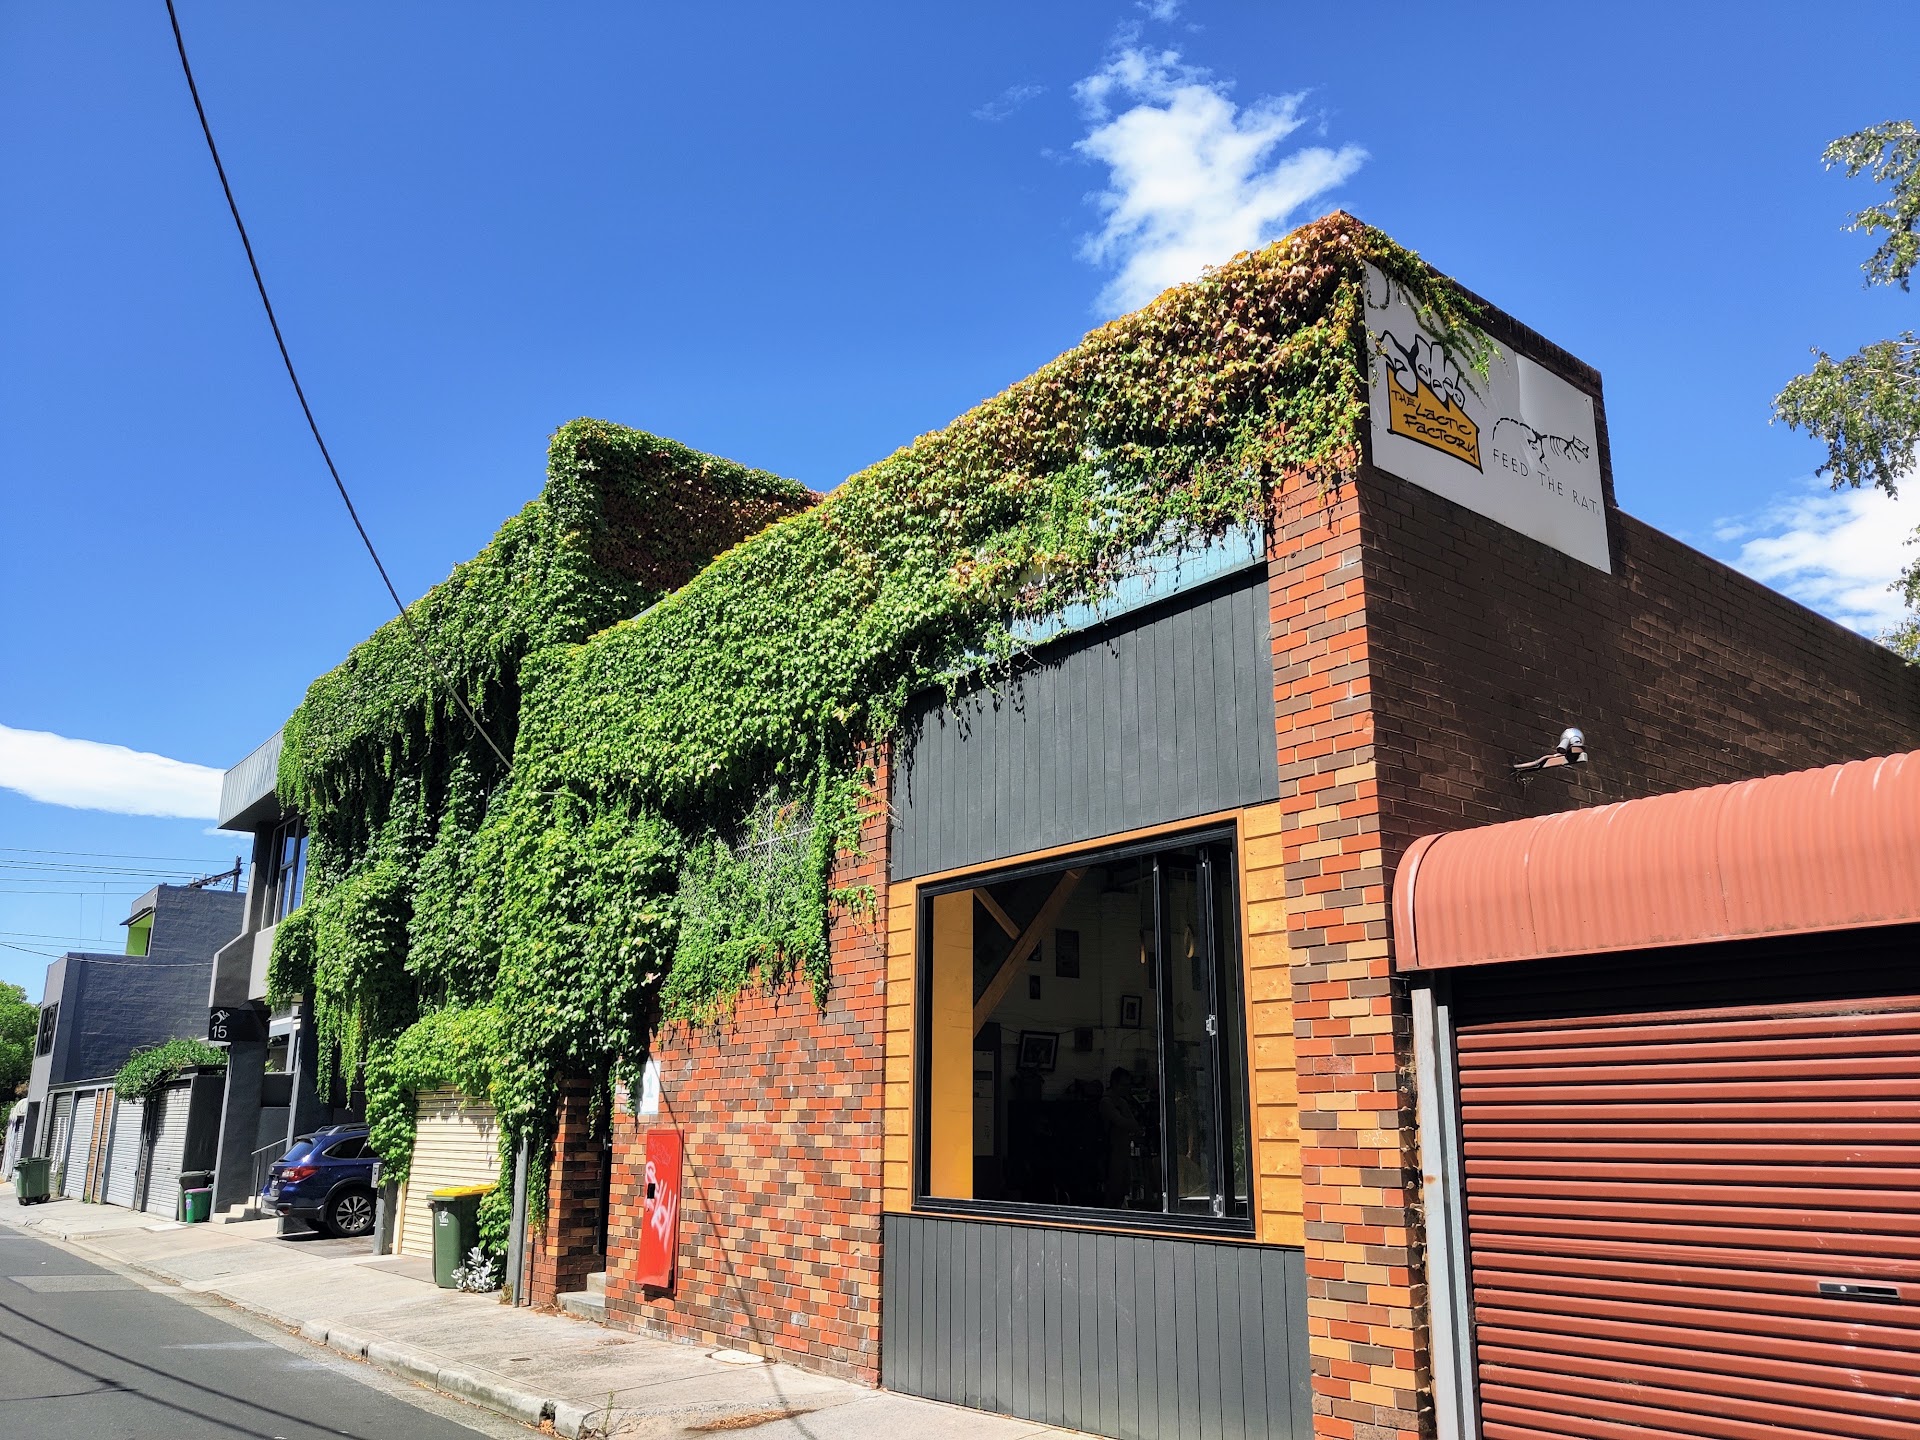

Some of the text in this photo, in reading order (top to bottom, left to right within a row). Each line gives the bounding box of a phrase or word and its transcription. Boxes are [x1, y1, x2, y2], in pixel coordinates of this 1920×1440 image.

[1391, 389, 1416, 407] THE
[1493, 448, 1529, 477] FEED
[1538, 470, 1564, 497] THE
[211, 1025, 227, 1039] 15
